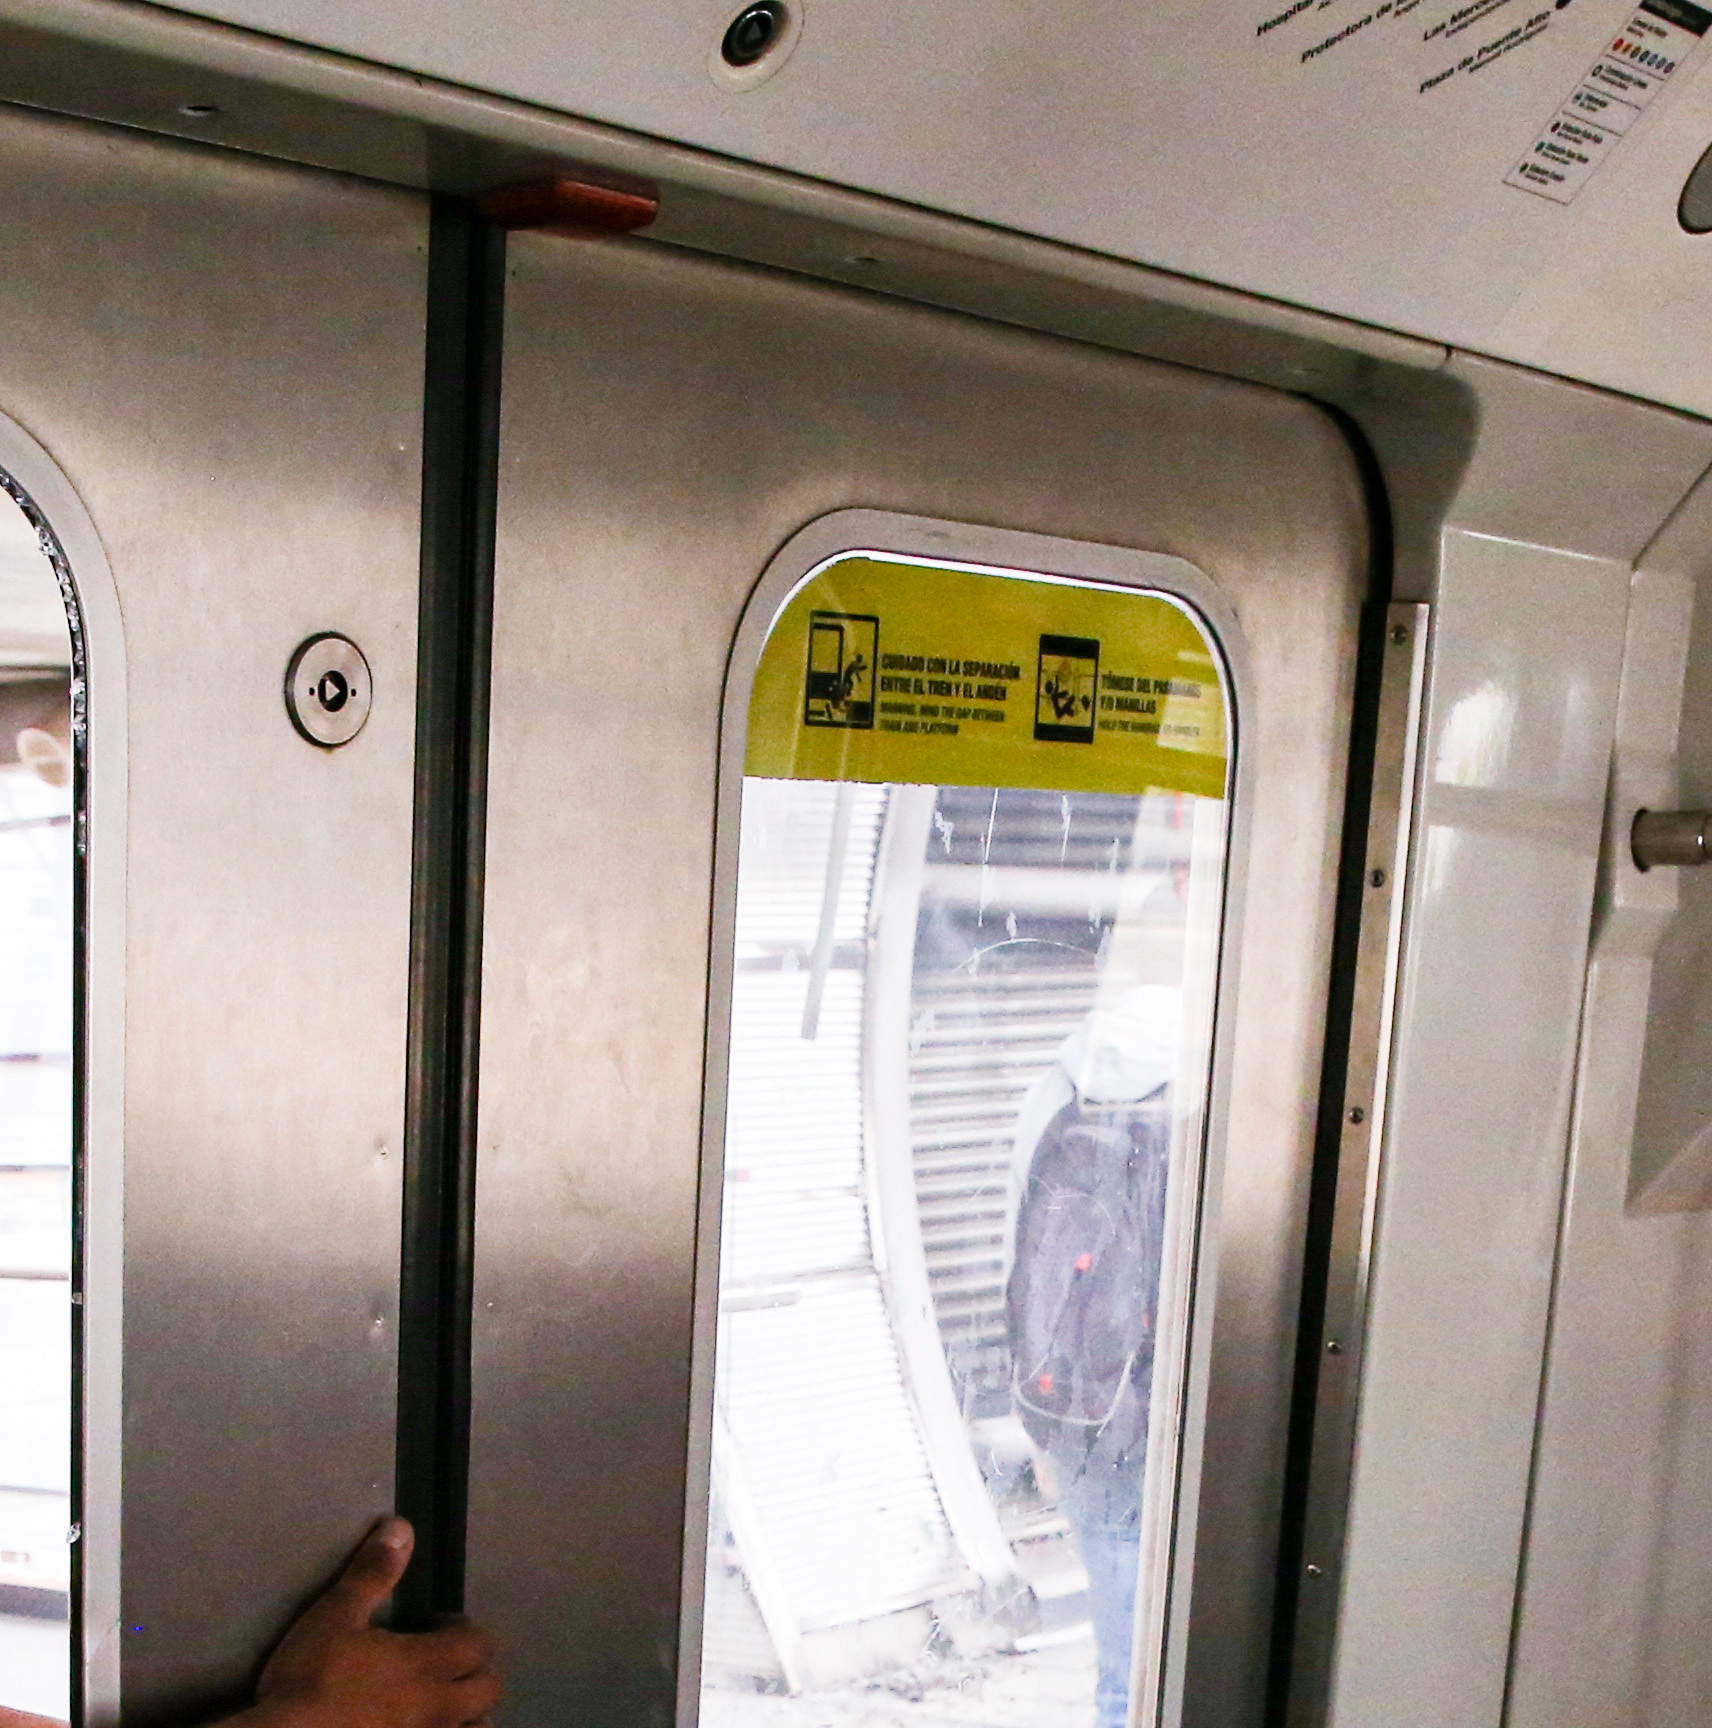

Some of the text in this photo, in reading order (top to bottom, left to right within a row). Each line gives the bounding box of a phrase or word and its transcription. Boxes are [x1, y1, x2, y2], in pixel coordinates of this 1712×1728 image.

[1376, 3, 1393, 18] de
[1420, 67, 1454, 94] Plaza
[1458, 55, 1474, 71] de
[1477, 27, 1523, 60] Puente
[1524, 10, 1551, 31] Alto
[881, 653, 1021, 680] CUIDADO CON LA SEPARACIÓN
[881, 675, 912, 693] ENTRE
[913, 678, 926, 695] EL
[927, 679, 953, 697] TREN
[963, 682, 975, 699] EL
[975, 681, 1007, 701] ANDÉN
[1115, 696, 1156, 715] MANILLAS
